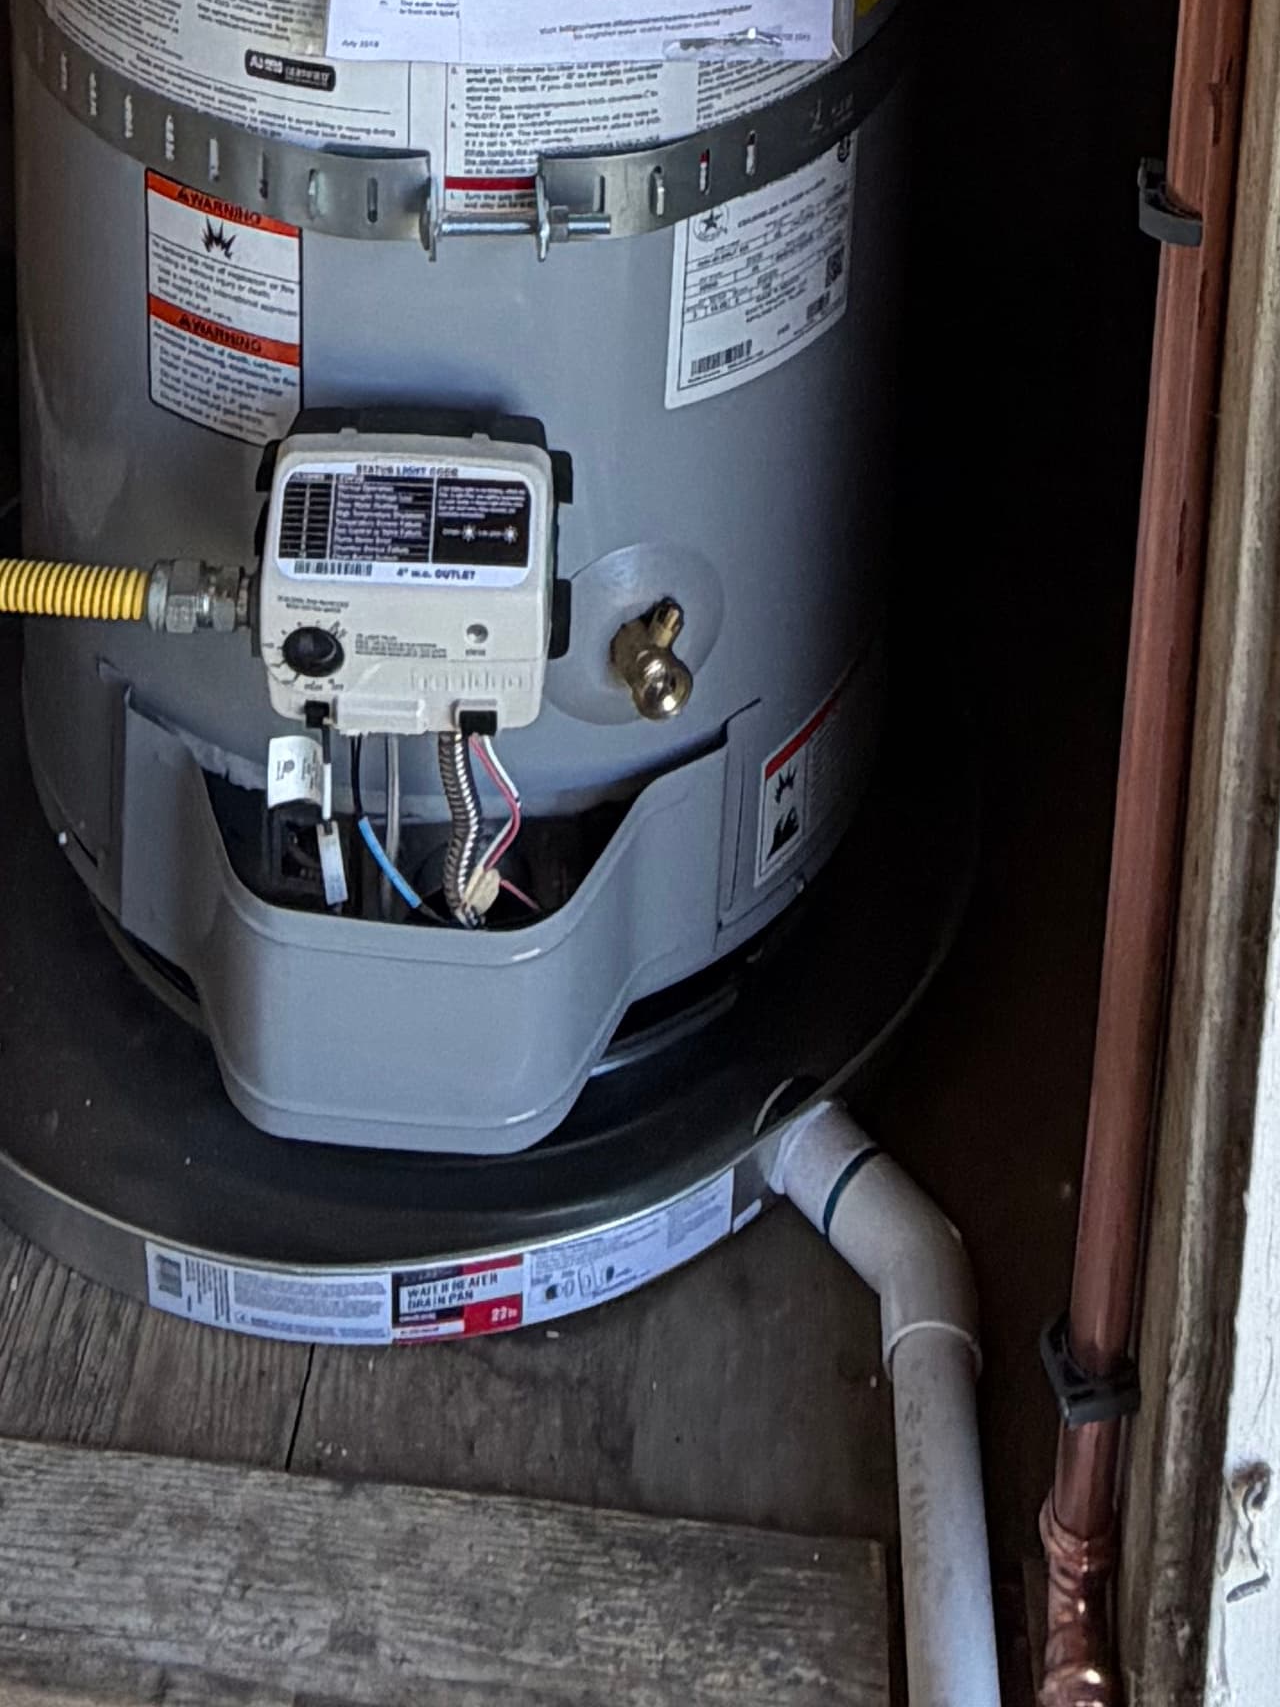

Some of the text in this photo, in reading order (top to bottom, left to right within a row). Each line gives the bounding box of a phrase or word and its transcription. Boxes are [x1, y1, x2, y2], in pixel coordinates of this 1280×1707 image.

[191, 189, 263, 226] WARNING
[194, 316, 263, 354] WARNING
[395, 465, 427, 477] LIGHT
[434, 568, 477, 582] OUTLET
[448, 1290, 475, 1306] PAN
